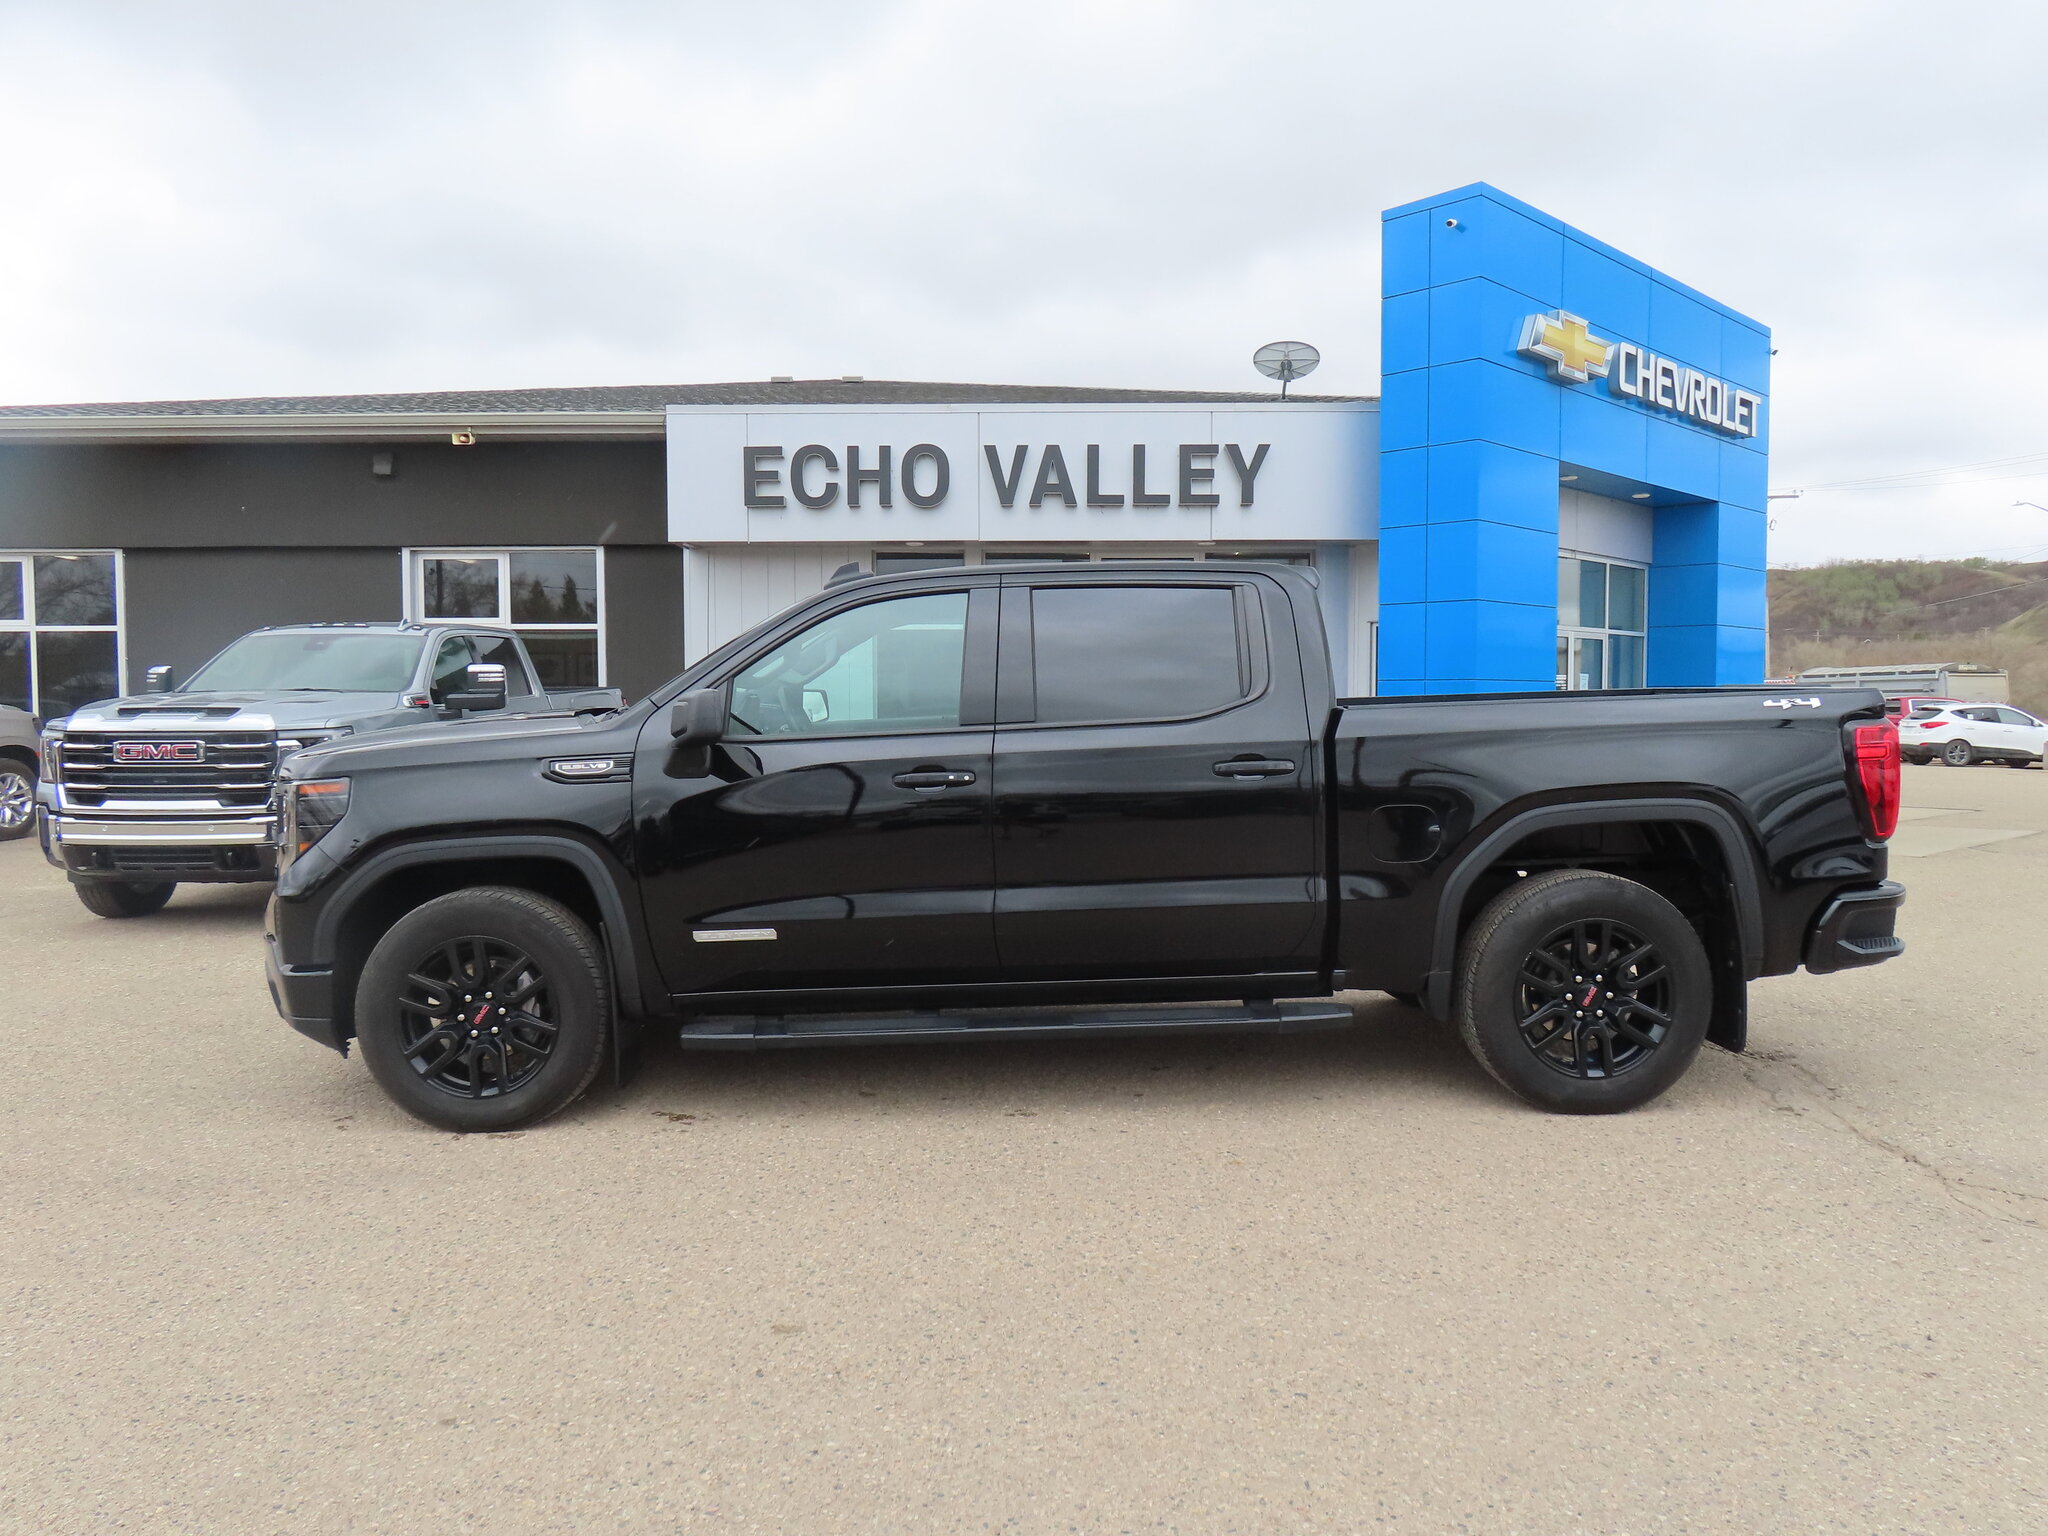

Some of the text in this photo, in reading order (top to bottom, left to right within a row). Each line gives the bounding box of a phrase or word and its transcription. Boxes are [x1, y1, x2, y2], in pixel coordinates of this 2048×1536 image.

[1617, 341, 1762, 438] CHEVROLET
[743, 443, 1271, 509] ECHO VALLEY
[117, 743, 198, 760] GMC
[473, 1004, 490, 1025] GMC
